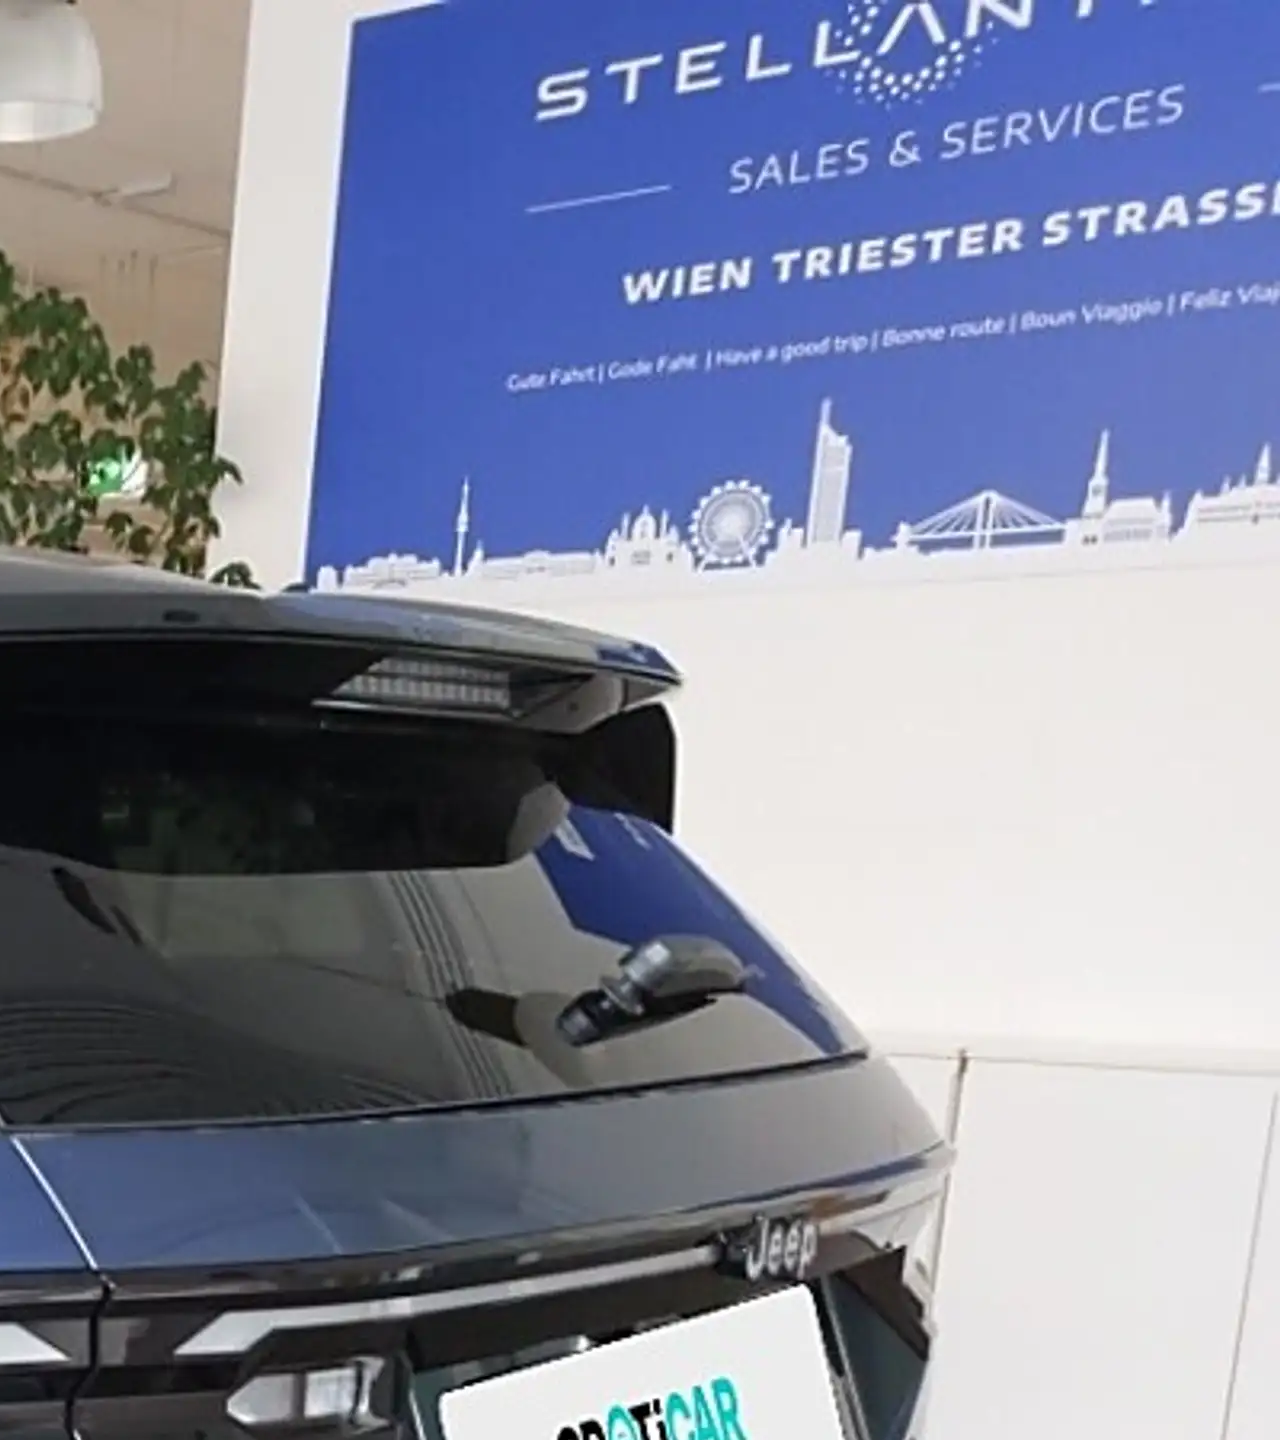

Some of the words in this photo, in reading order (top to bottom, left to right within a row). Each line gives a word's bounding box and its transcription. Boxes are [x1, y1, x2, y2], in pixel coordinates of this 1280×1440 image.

[535, 0, 1154, 120] STELLAN
[728, 136, 871, 196] SALES
[887, 130, 923, 169] &
[940, 84, 1186, 160] SERVICES
[621, 256, 753, 304] WIEN
[772, 218, 1024, 285] TRIESTER
[746, 1215, 818, 1280] Jeep
